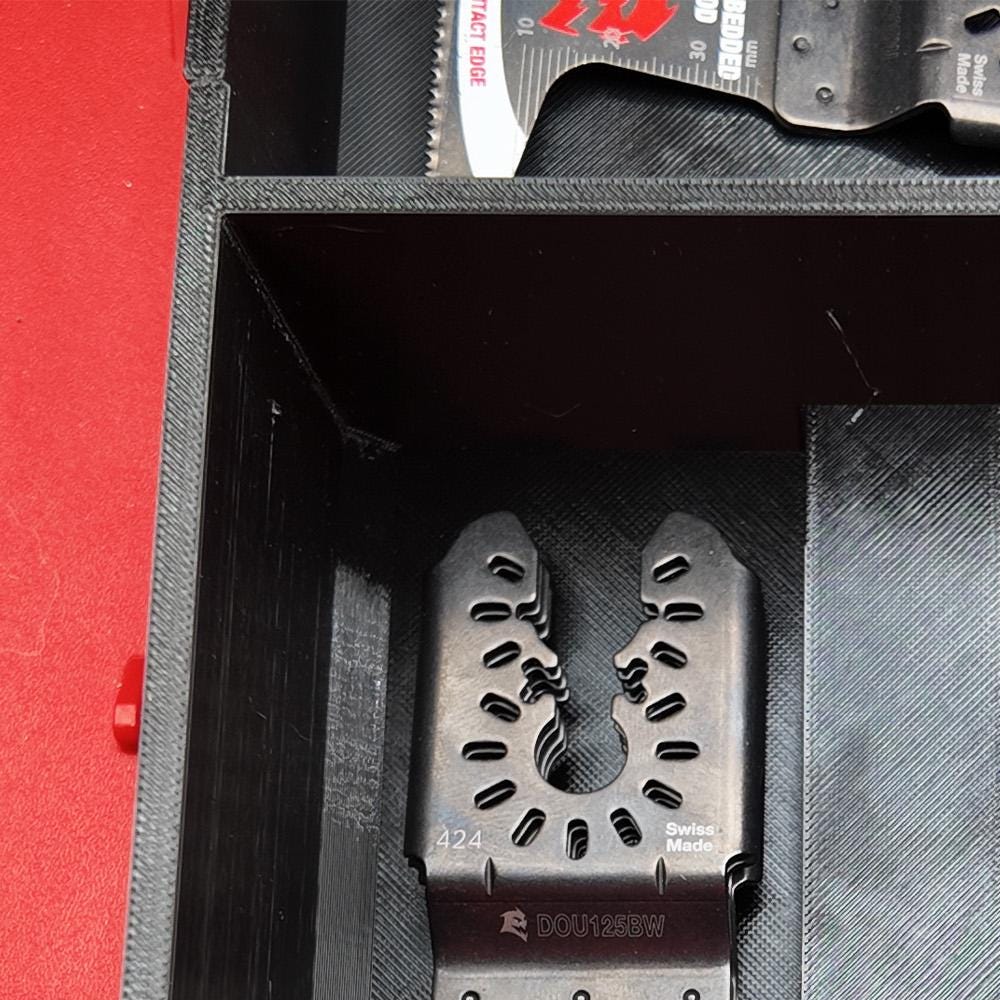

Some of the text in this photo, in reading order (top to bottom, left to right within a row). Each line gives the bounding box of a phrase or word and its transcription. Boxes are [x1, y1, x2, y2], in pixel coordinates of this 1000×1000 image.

[516, 17, 535, 36] 10
[470, 0, 488, 87] TACT EDGE
[689, 40, 707, 62] 30
[745, 40, 759, 68] mm
[956, 53, 971, 94] Made
[972, 54, 988, 97] Swiss
[436, 830, 482, 849] 424
[665, 822, 715, 837] Swiss
[666, 838, 713, 852] Made
[536, 913, 666, 938] DOU125BW
